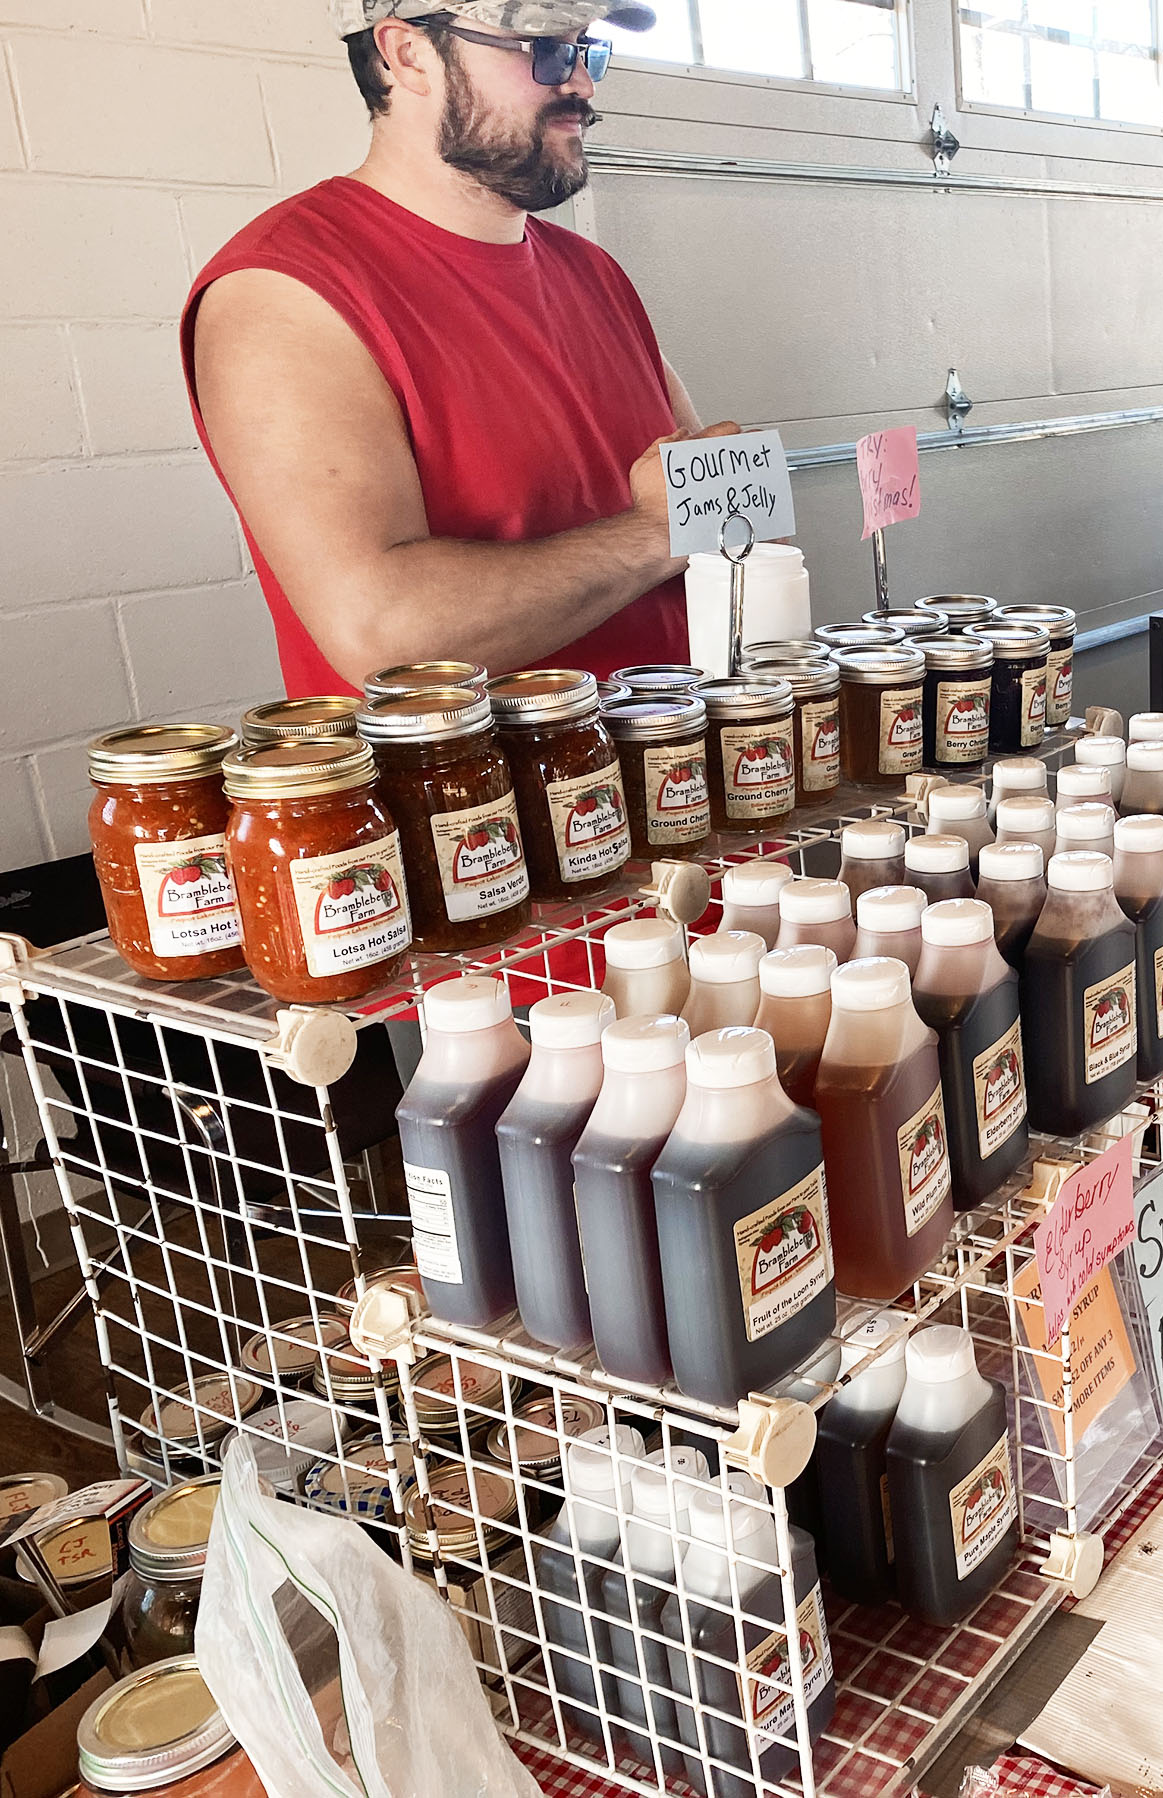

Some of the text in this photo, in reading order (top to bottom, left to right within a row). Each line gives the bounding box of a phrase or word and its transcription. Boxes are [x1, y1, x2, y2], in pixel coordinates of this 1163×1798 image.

[676, 498, 723, 526] Jams
[741, 483, 776, 517] Jelly
[761, 772, 780, 781] Farm
[686, 794, 702, 804] Farm
[727, 788, 788, 801] Ground Cherry
[593, 823, 611, 835] Farm
[651, 818, 687, 828] Ground
[569, 837, 628, 867] Kinda Hot Salsa
[485, 859, 506, 871] Farm
[480, 875, 524, 900] Salsa Verde
[195, 896, 224, 908] Farm
[350, 908, 376, 922] Farm
[172, 920, 231, 939] Lotsa Hot
[333, 925, 406, 958] Lotsa Hot Salsa
[1089, 1062, 1103, 1072] Black
[1109, 1051, 1118, 1061] Blue
[1120, 1042, 1130, 1055] Syrup
[986, 1114, 1012, 1139] Elderberry
[912, 1200, 925, 1216] Wild
[926, 1185, 937, 1203] Plum
[1045, 1163, 1119, 1274] Elderberry
[778, 1254, 798, 1273] Farm
[752, 1269, 825, 1326] Fruit of the Loon Syrup
[1072, 1284, 1100, 1320] SYRUP
[755, 1324, 766, 1335] Net
[1080, 1351, 1094, 1372] OFF
[1094, 1338, 1108, 1359] ANY
[1108, 1330, 1114, 1340] 3
[1072, 1357, 1116, 1416] MORE ITEMS
[978, 1505, 992, 1523] Farm
[964, 1506, 1010, 1562] Pure Maple Syrup
